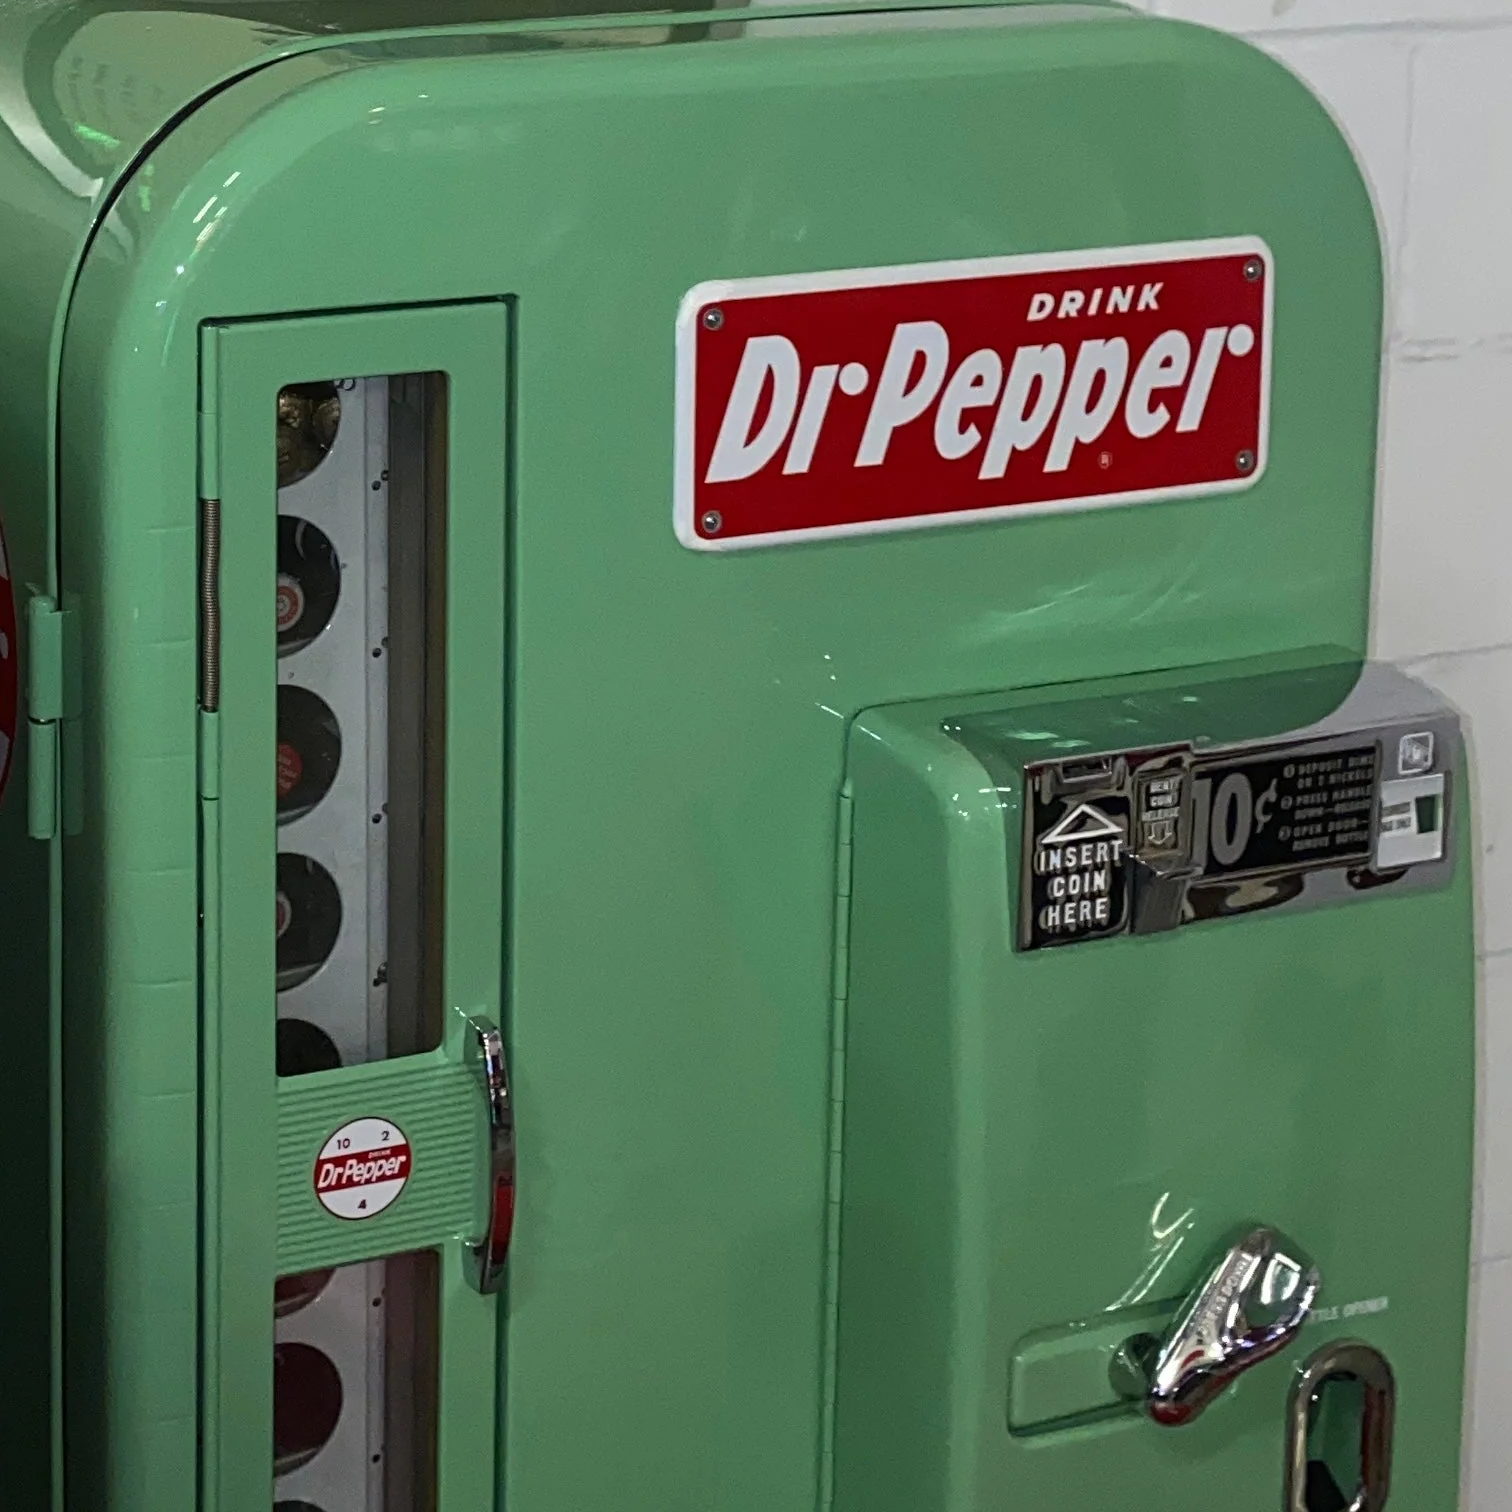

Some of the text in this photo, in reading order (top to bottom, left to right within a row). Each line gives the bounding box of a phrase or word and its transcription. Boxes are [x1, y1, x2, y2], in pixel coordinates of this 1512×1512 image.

[1026, 282, 1164, 322] DRINK
[1040, 840, 1123, 872] INSERT
[1053, 869, 1106, 897] COIN
[1048, 897, 1108, 927] HERE
[337, 1130, 390, 1150] 10 2
[357, 1199, 367, 1210] 4
